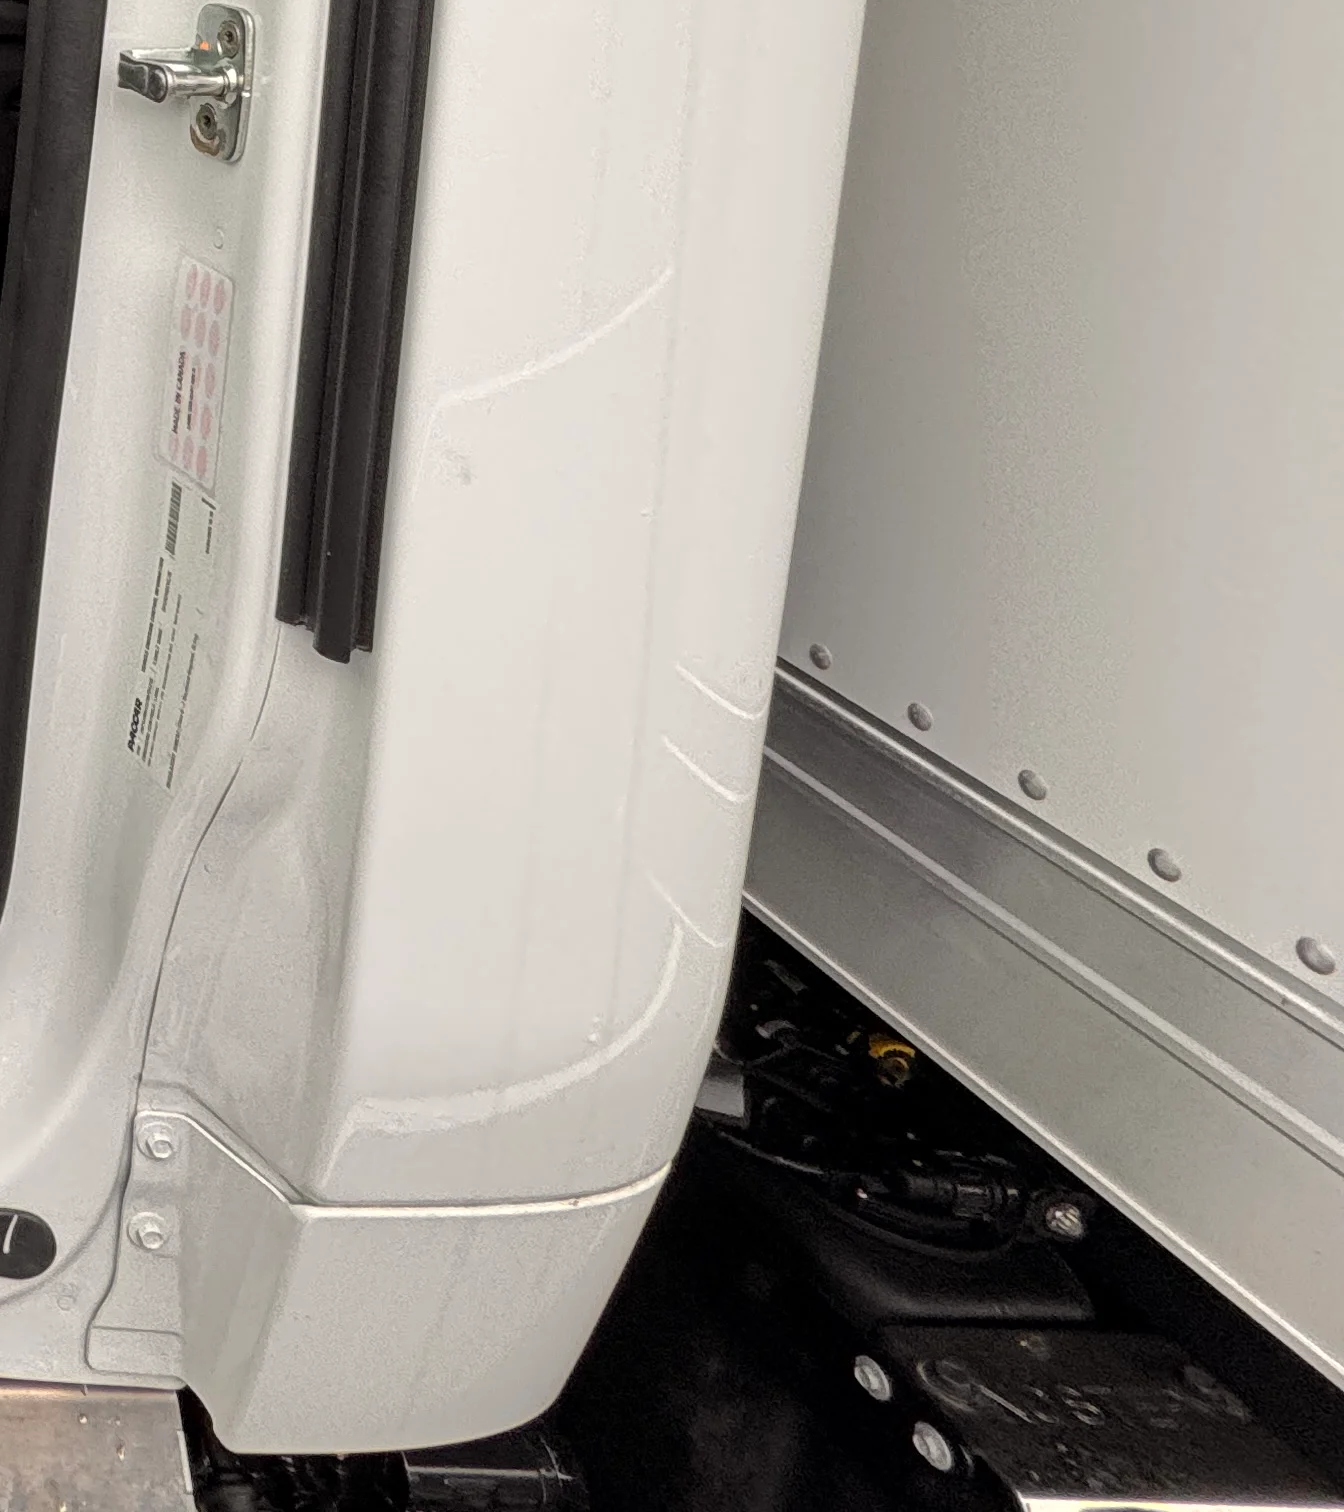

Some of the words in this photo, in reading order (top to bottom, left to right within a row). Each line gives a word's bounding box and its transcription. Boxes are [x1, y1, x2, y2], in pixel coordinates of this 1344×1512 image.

[171, 407, 180, 434] MADE
[176, 351, 186, 391] CANADA
[127, 698, 142, 752] PACCAR
